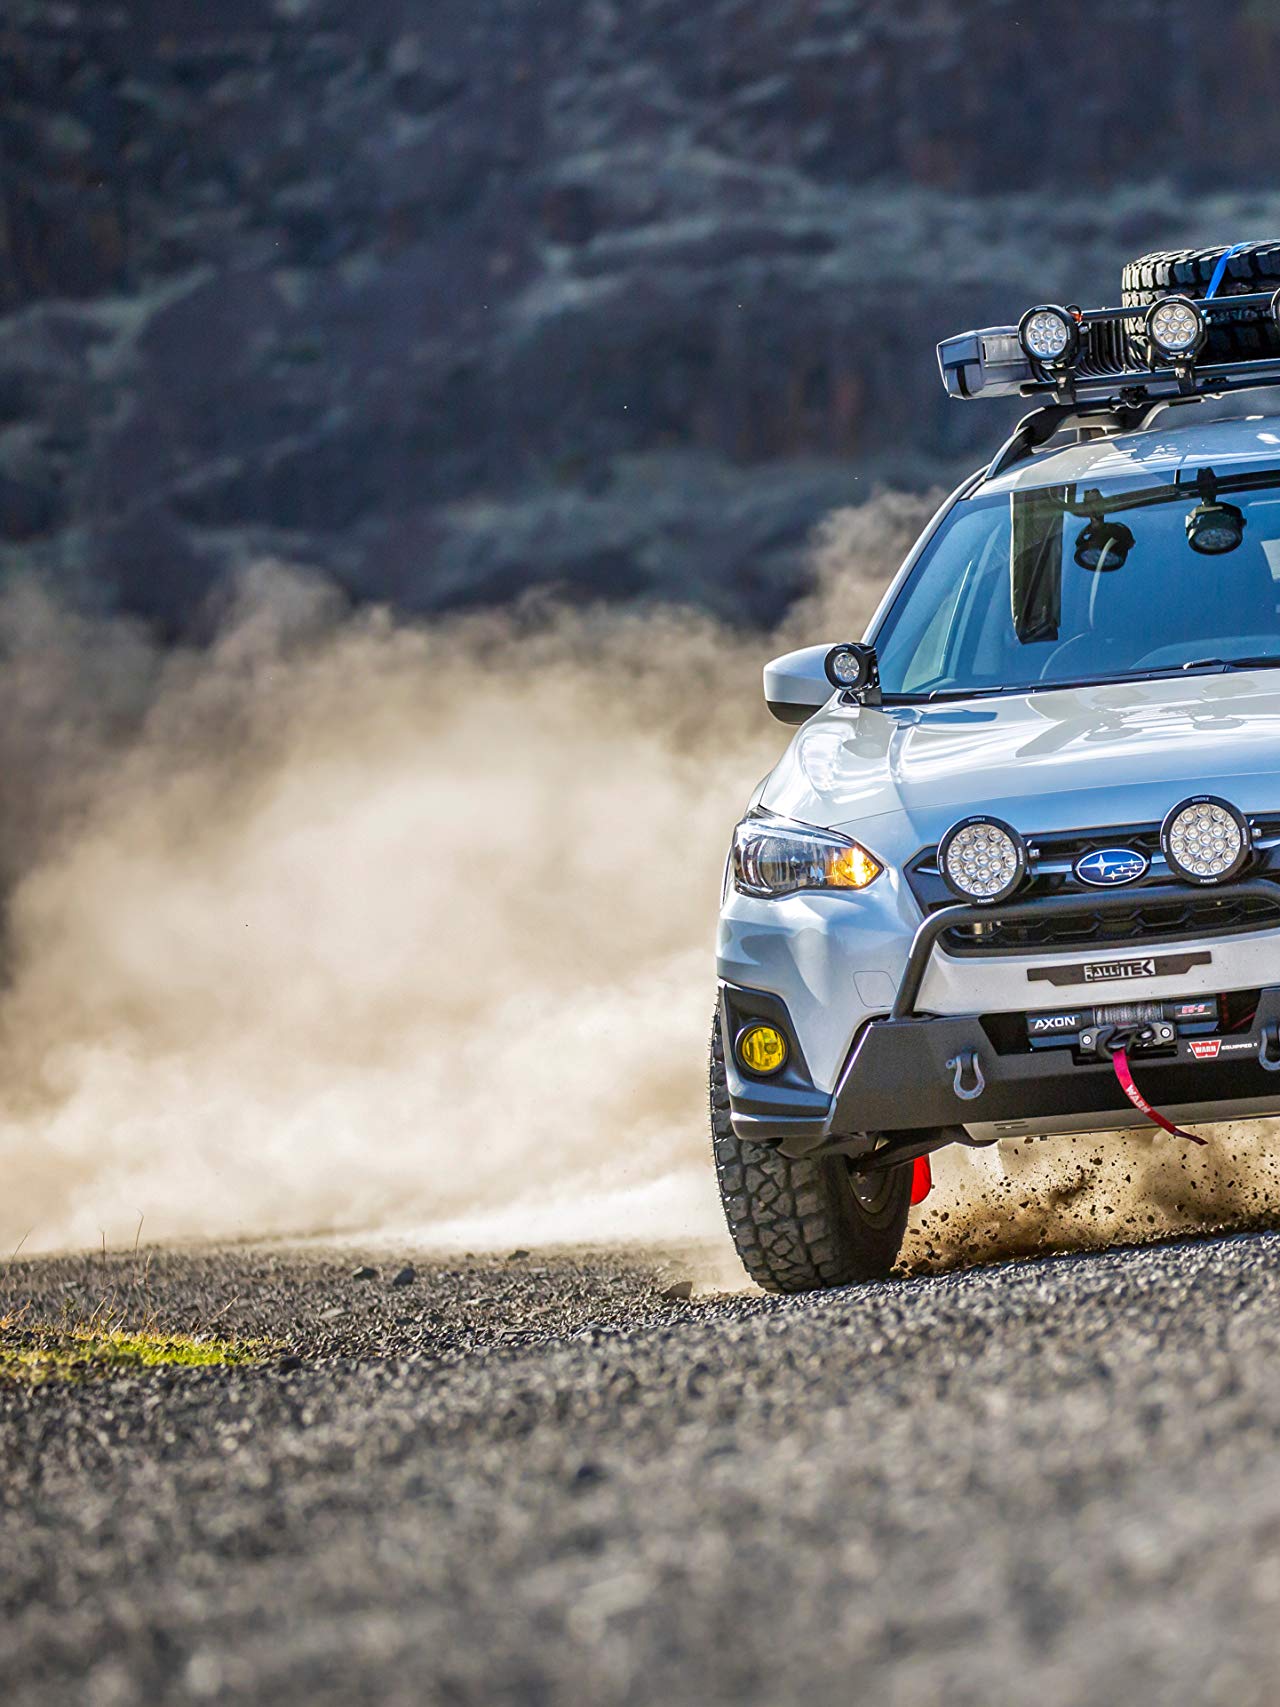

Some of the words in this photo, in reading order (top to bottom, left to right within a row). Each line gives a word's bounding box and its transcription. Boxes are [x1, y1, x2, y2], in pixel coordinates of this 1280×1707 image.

[1034, 1016, 1076, 1030] AXON
[1195, 1045, 1217, 1054] WARN
[1126, 1084, 1152, 1114] WARN
